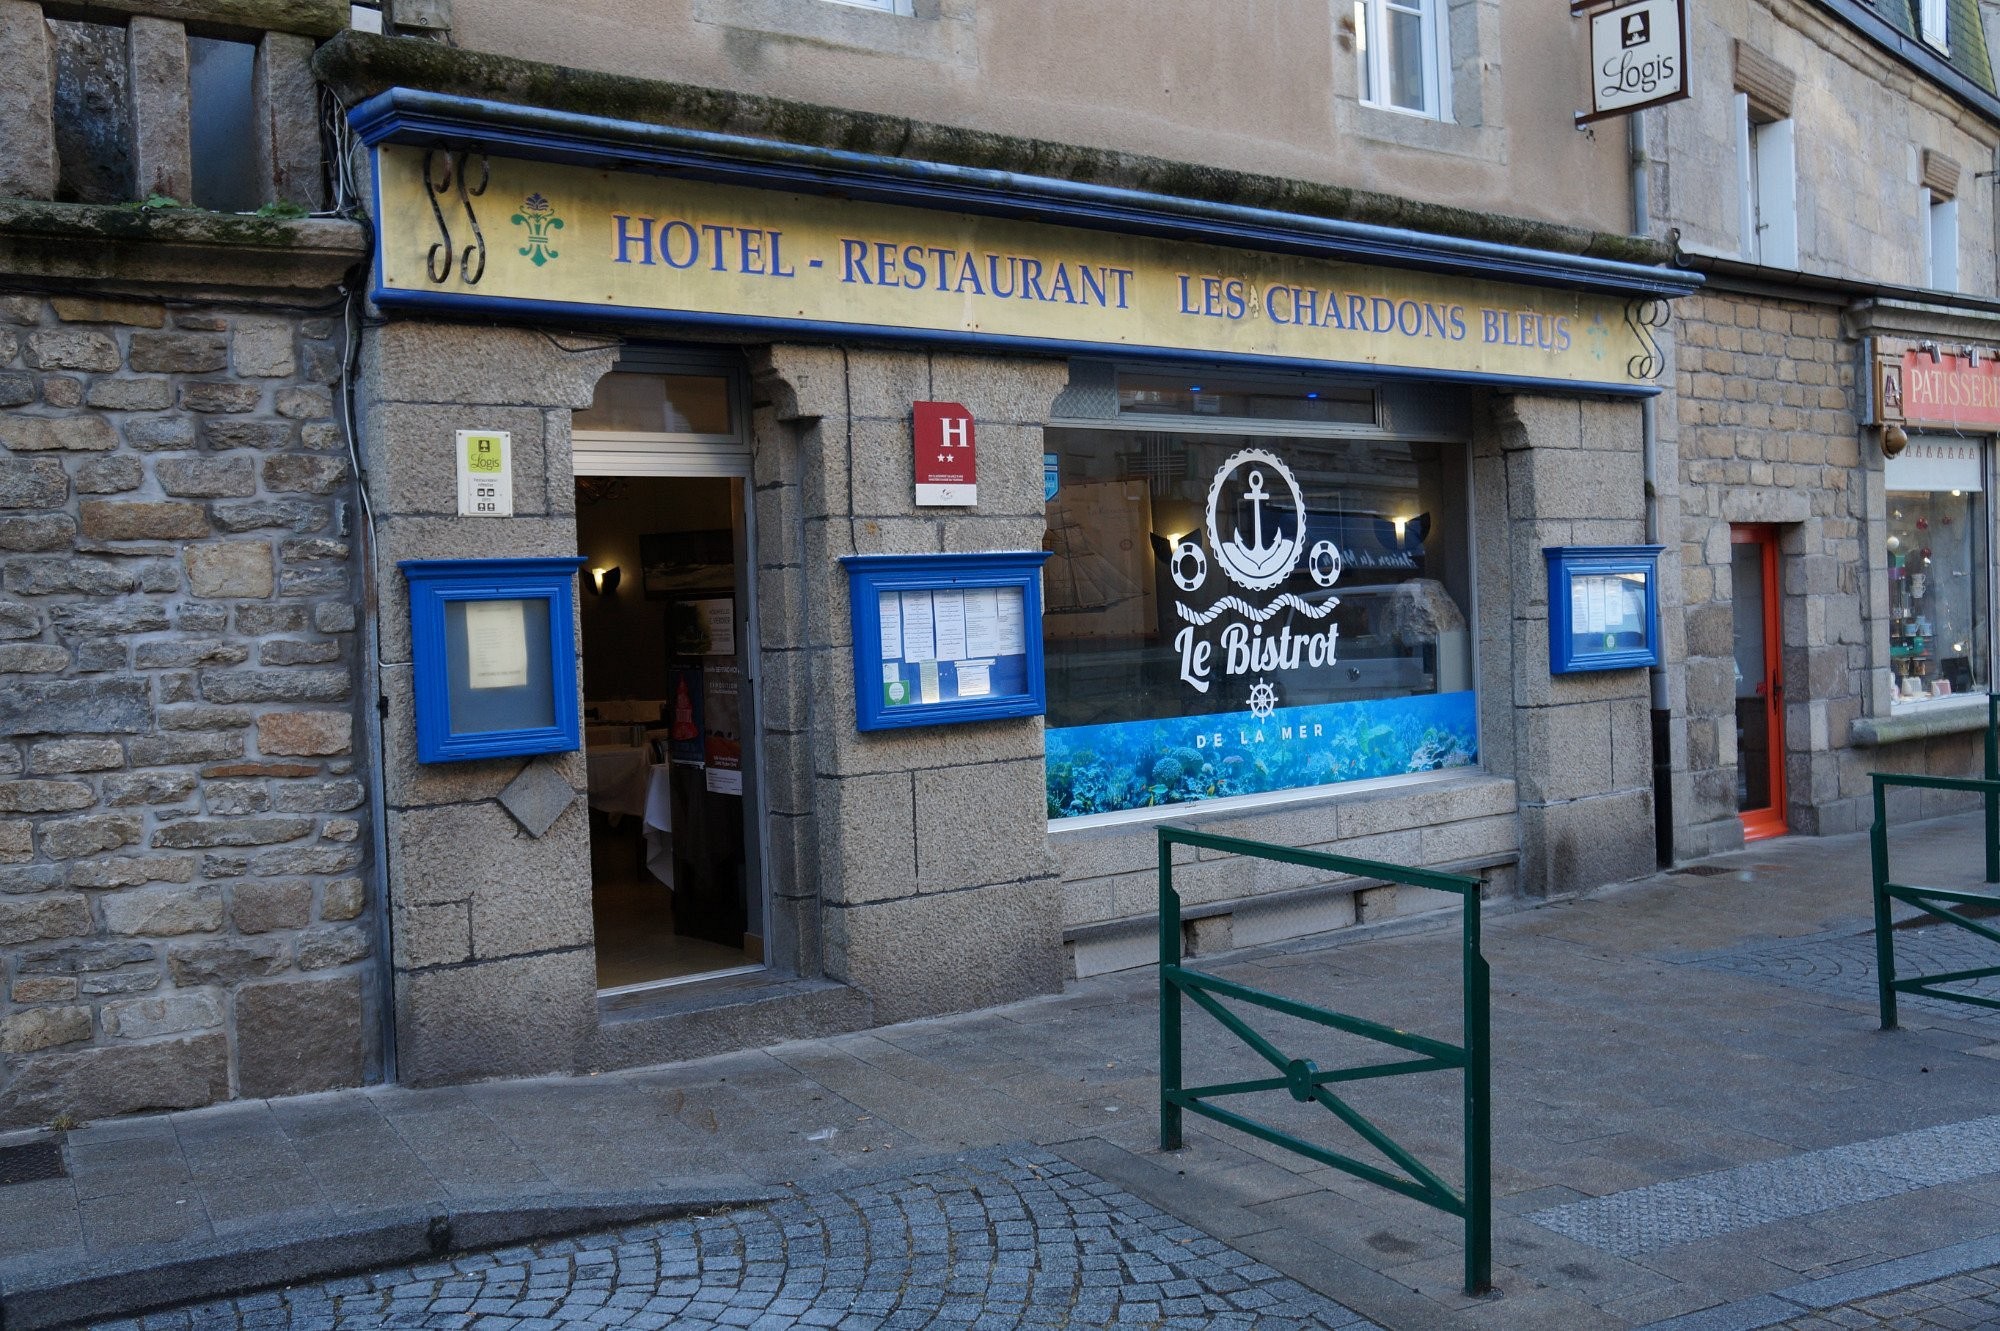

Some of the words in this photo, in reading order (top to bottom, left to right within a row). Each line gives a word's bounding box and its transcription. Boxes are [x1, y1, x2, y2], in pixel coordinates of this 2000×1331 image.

[1601, 50, 1674, 97] Logis
[612, 214, 795, 278] HOTEL
[841, 238, 1133, 309] RESTAURANT
[1179, 274, 1245, 321] LES
[1265, 285, 1467, 341] CHARDONS
[1482, 307, 1571, 350] BLEUS
[940, 418, 970, 447] H
[470, 453, 500, 471] Logis
[1175, 626, 1211, 693] Le
[1220, 623, 1339, 676] Bistrot
[1196, 734, 1223, 748] DE
[1240, 730, 1265, 744] LA
[1281, 724, 1323, 740] MER
